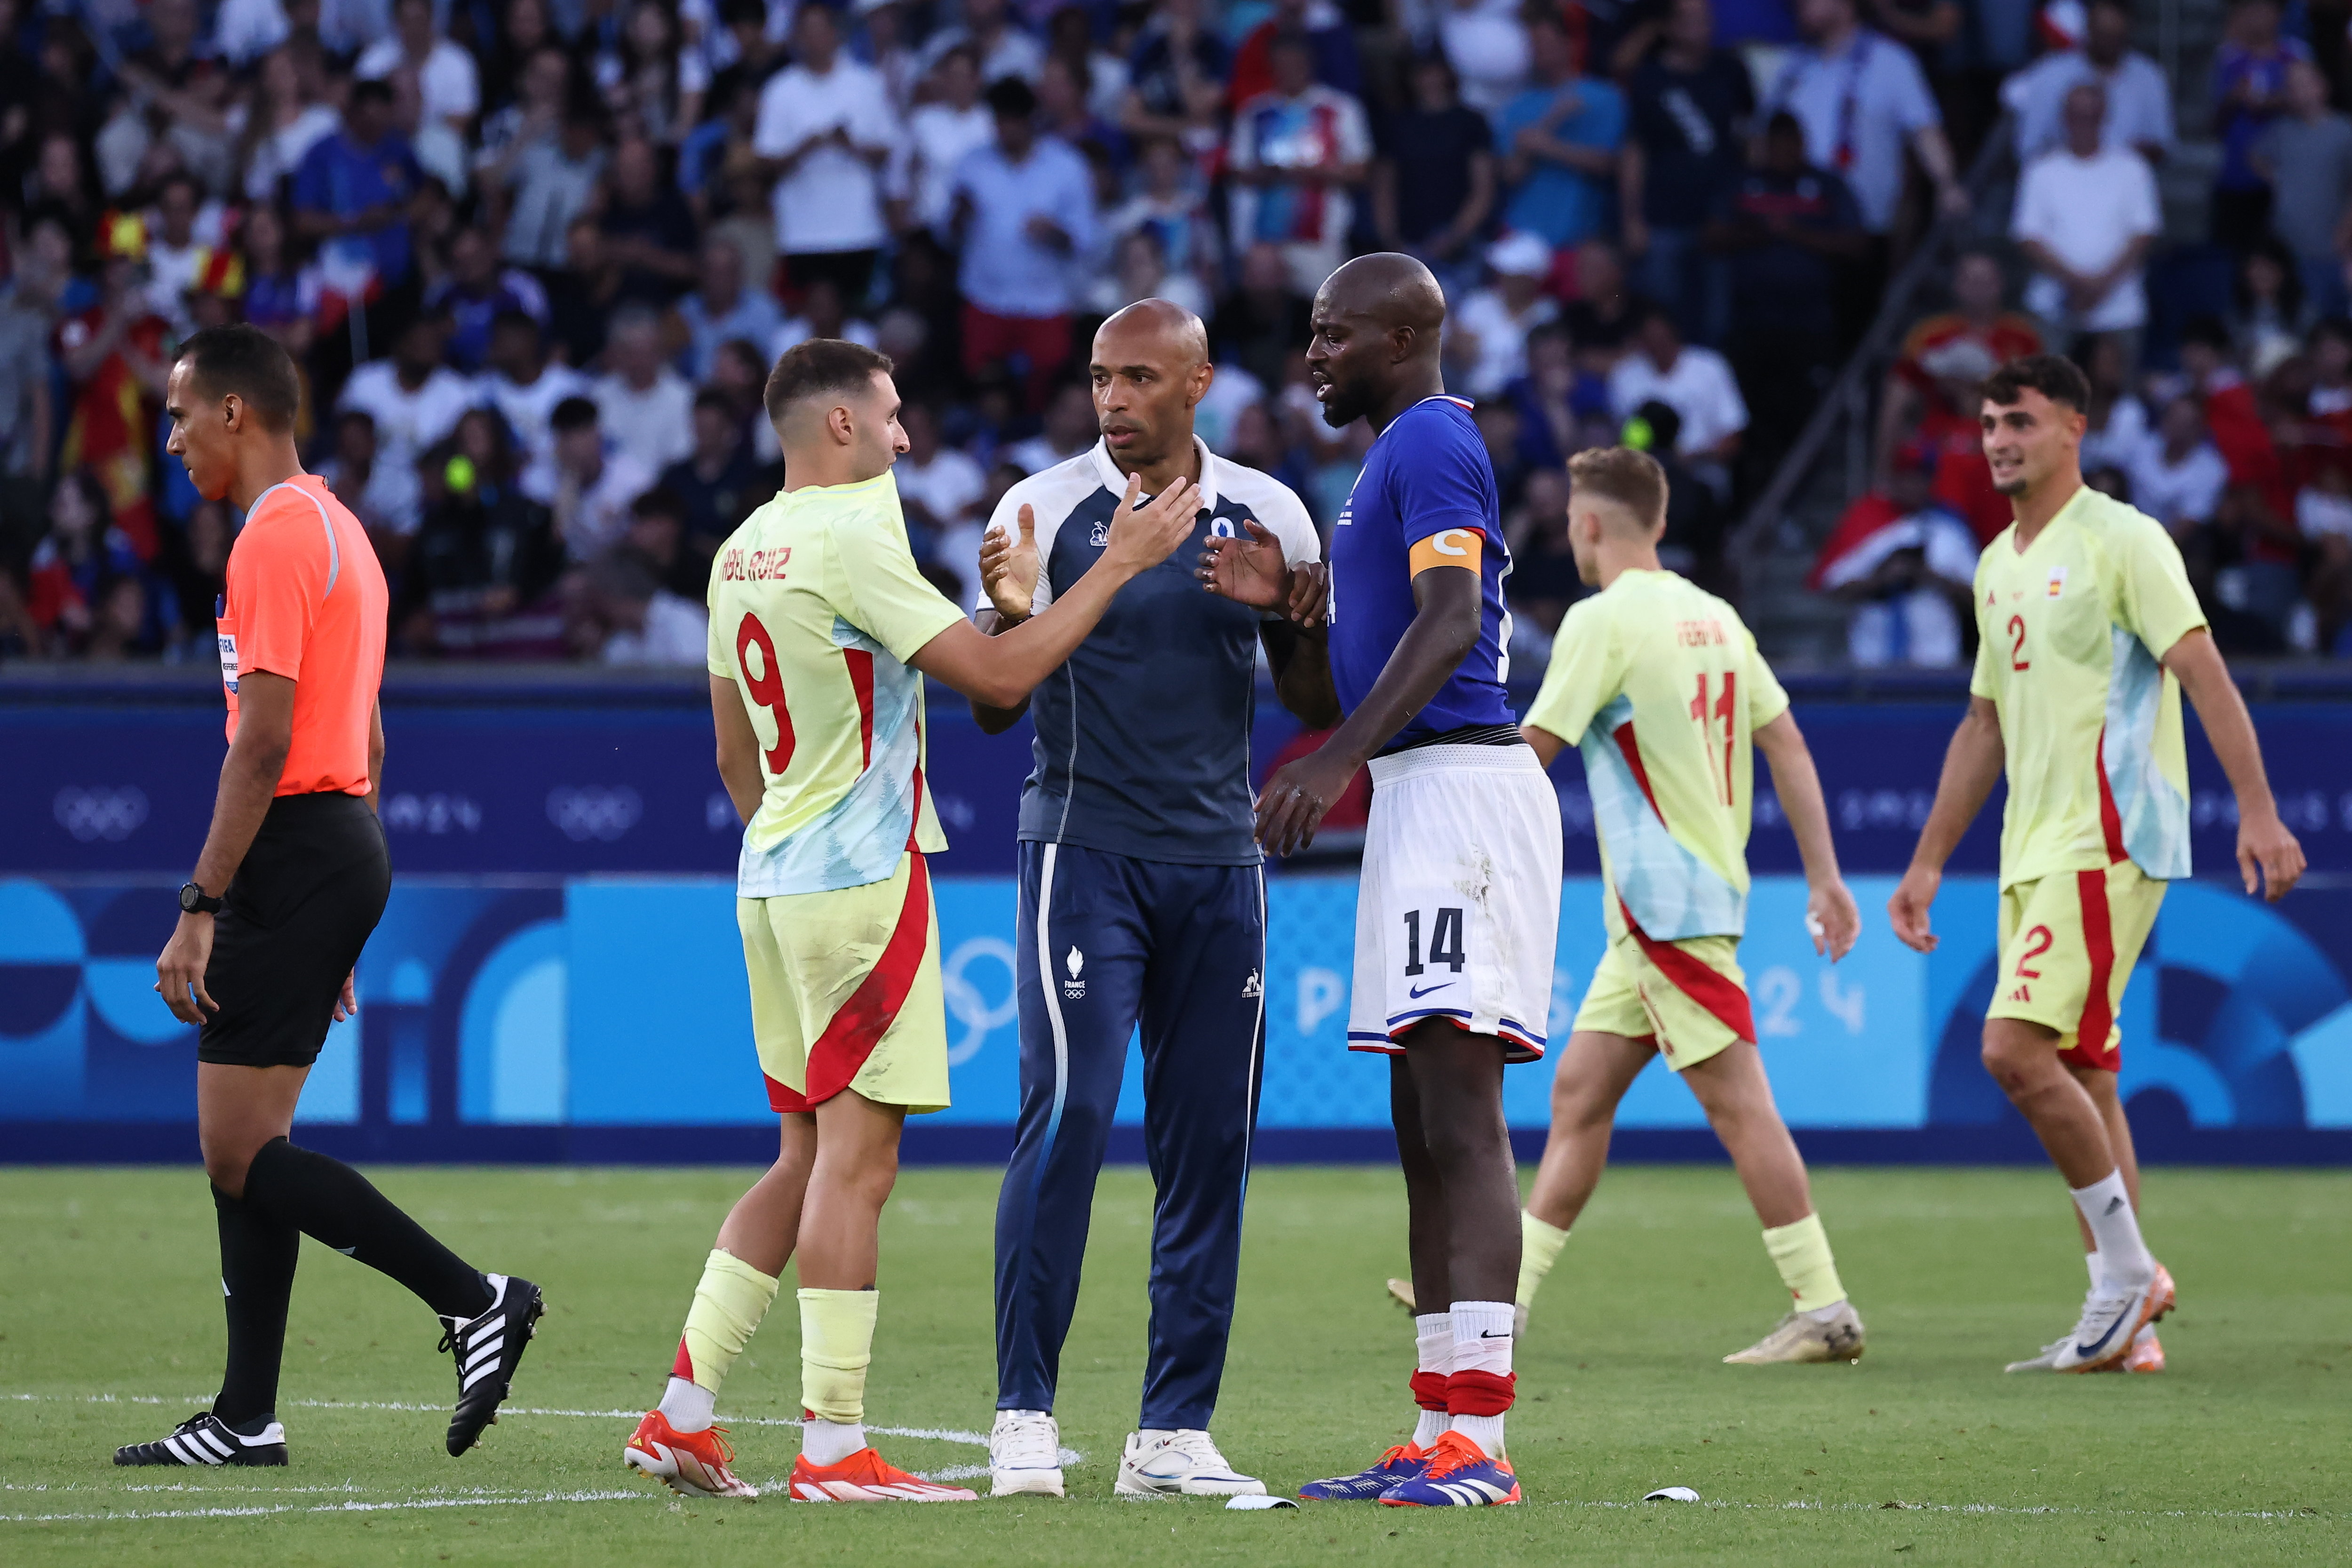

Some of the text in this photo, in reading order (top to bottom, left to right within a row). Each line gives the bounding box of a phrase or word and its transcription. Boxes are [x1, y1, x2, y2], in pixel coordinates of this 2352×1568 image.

[722, 547, 792, 582] ABEL RUIZ
[1432, 528, 1471, 556] C
[218, 638, 235, 653] FIFA
[2008, 615, 2030, 671] 2
[736, 612, 795, 774] 9
[1690, 671, 1735, 806] 11
[1404, 908, 1465, 977] 14
[2016, 924, 2052, 980] 2
[1065, 980, 1085, 988] FRANCE
[1756, 966, 1866, 1036] 24
